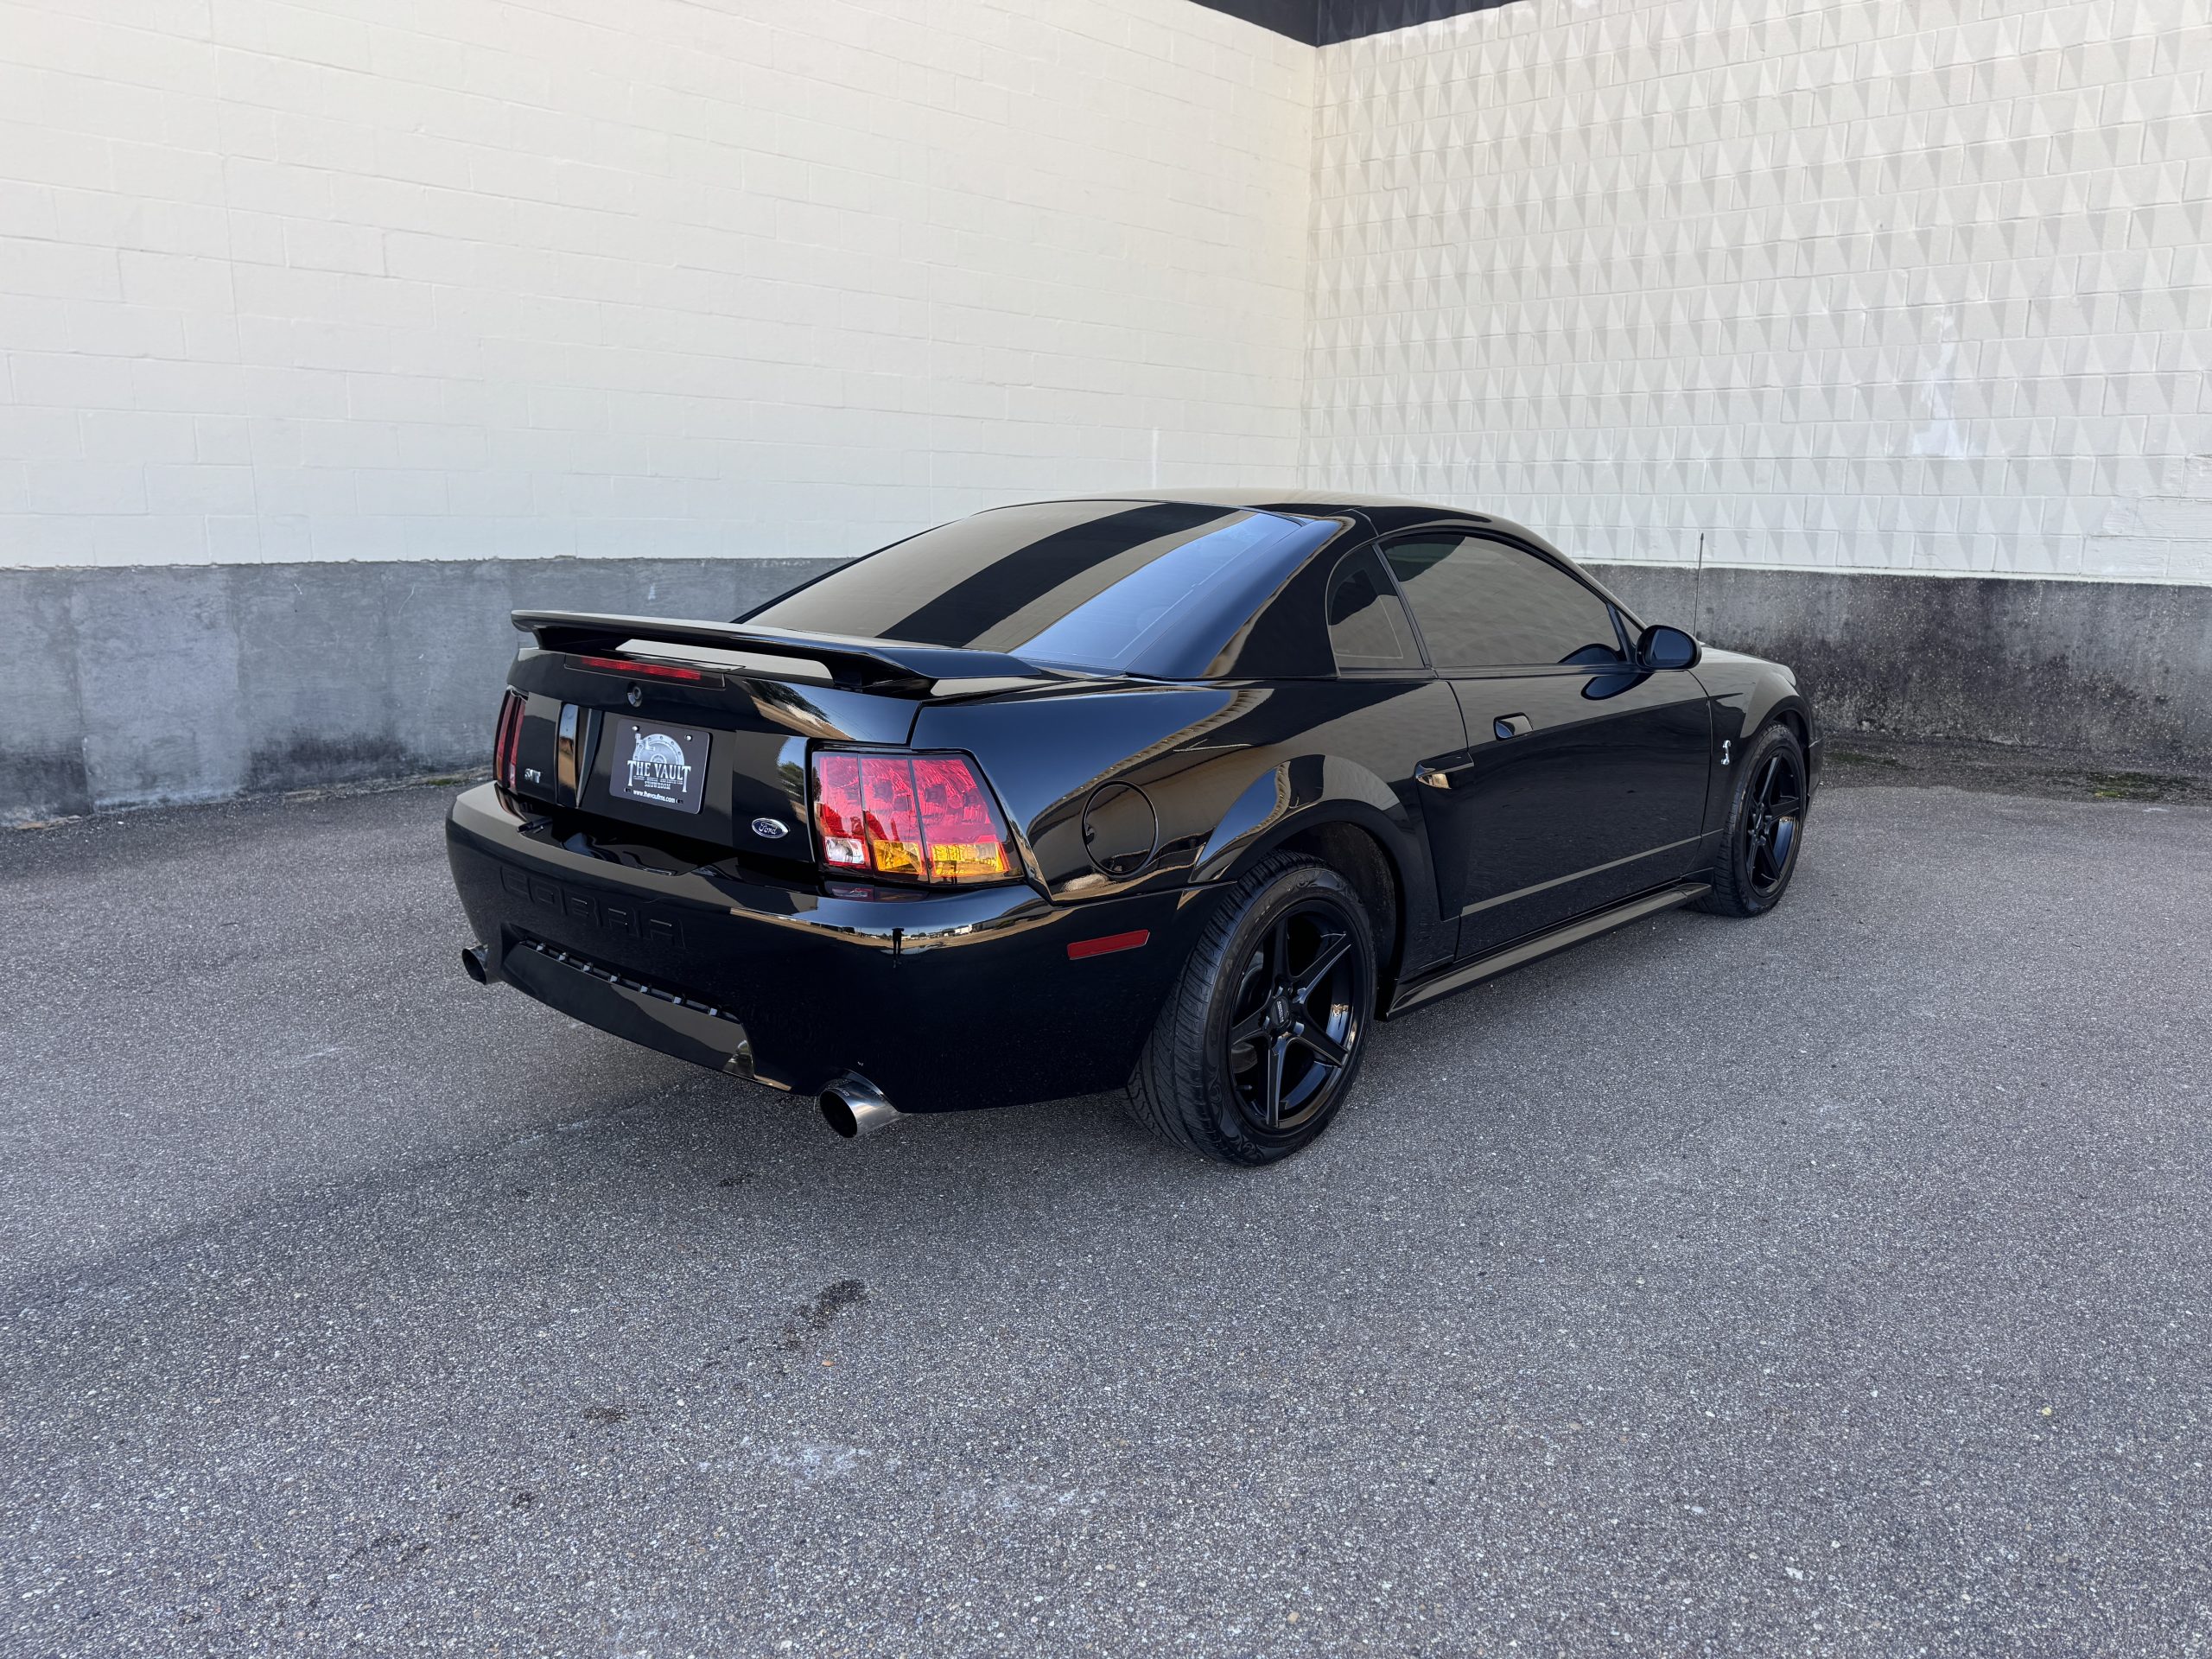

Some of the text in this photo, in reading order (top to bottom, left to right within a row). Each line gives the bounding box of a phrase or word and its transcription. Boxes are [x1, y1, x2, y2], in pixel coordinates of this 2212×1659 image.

[627, 760, 691, 793] THE VAULT
[758, 821, 777, 835] Ford
[499, 865, 688, 951] COBRA
